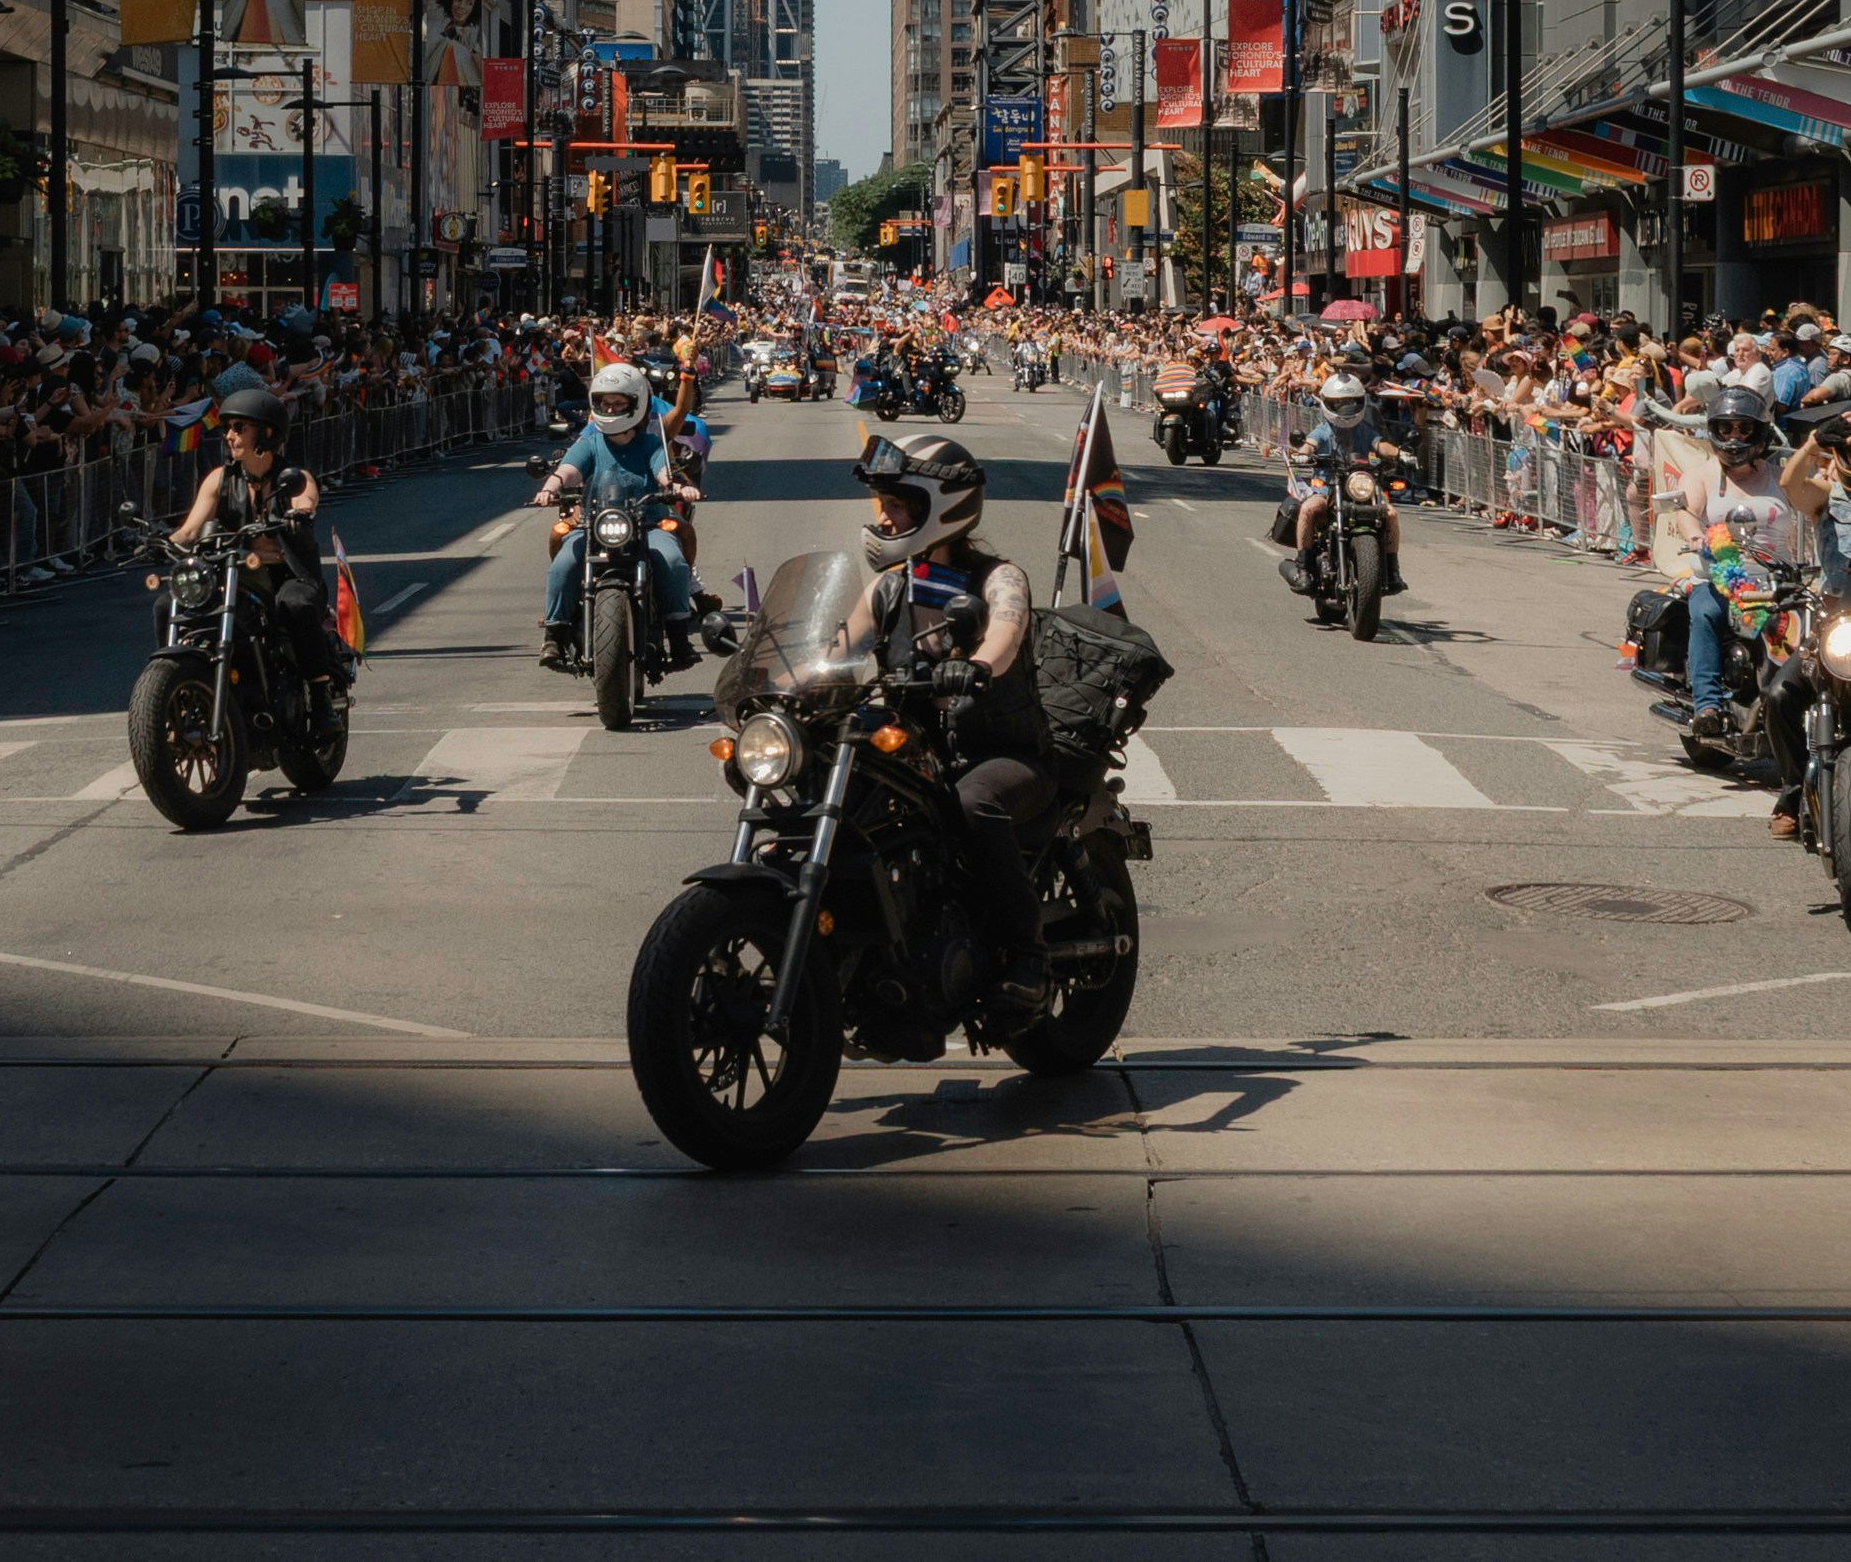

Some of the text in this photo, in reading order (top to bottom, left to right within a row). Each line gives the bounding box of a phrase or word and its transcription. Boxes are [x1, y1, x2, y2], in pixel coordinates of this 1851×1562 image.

[356, 6, 396, 15] SHOP IN
[354, 14, 409, 24] TORONTO'S
[360, 23, 411, 33] CULTURAL
[356, 32, 387, 42] HEART
[1231, 42, 1273, 51] EXPLORE
[1228, 51, 1281, 60] TORONTO'S
[580, 28, 597, 111] Yonge
[1135, 33, 1143, 105] DOWNTOWN
[1236, 60, 1284, 69] CULTURAL
[1100, 32, 1116, 114] Yonge
[1230, 69, 1261, 78] HEART
[1734, 81, 1791, 109] THE TENOR
[1163, 100, 1202, 108] CULTURAL
[1158, 107, 1184, 115] HEART
[1648, 106, 1666, 123] THE
[1049, 78, 1061, 218] ZANZIBAR
[1526, 142, 1569, 161] THE TENOR
[1435, 163, 1472, 183] THE TENOR
[1373, 190, 1394, 203] TENOR
[1774, 183, 1819, 238] CANADA
[1011, 272, 1025, 282] 40
[906, 459, 978, 483] 100%
